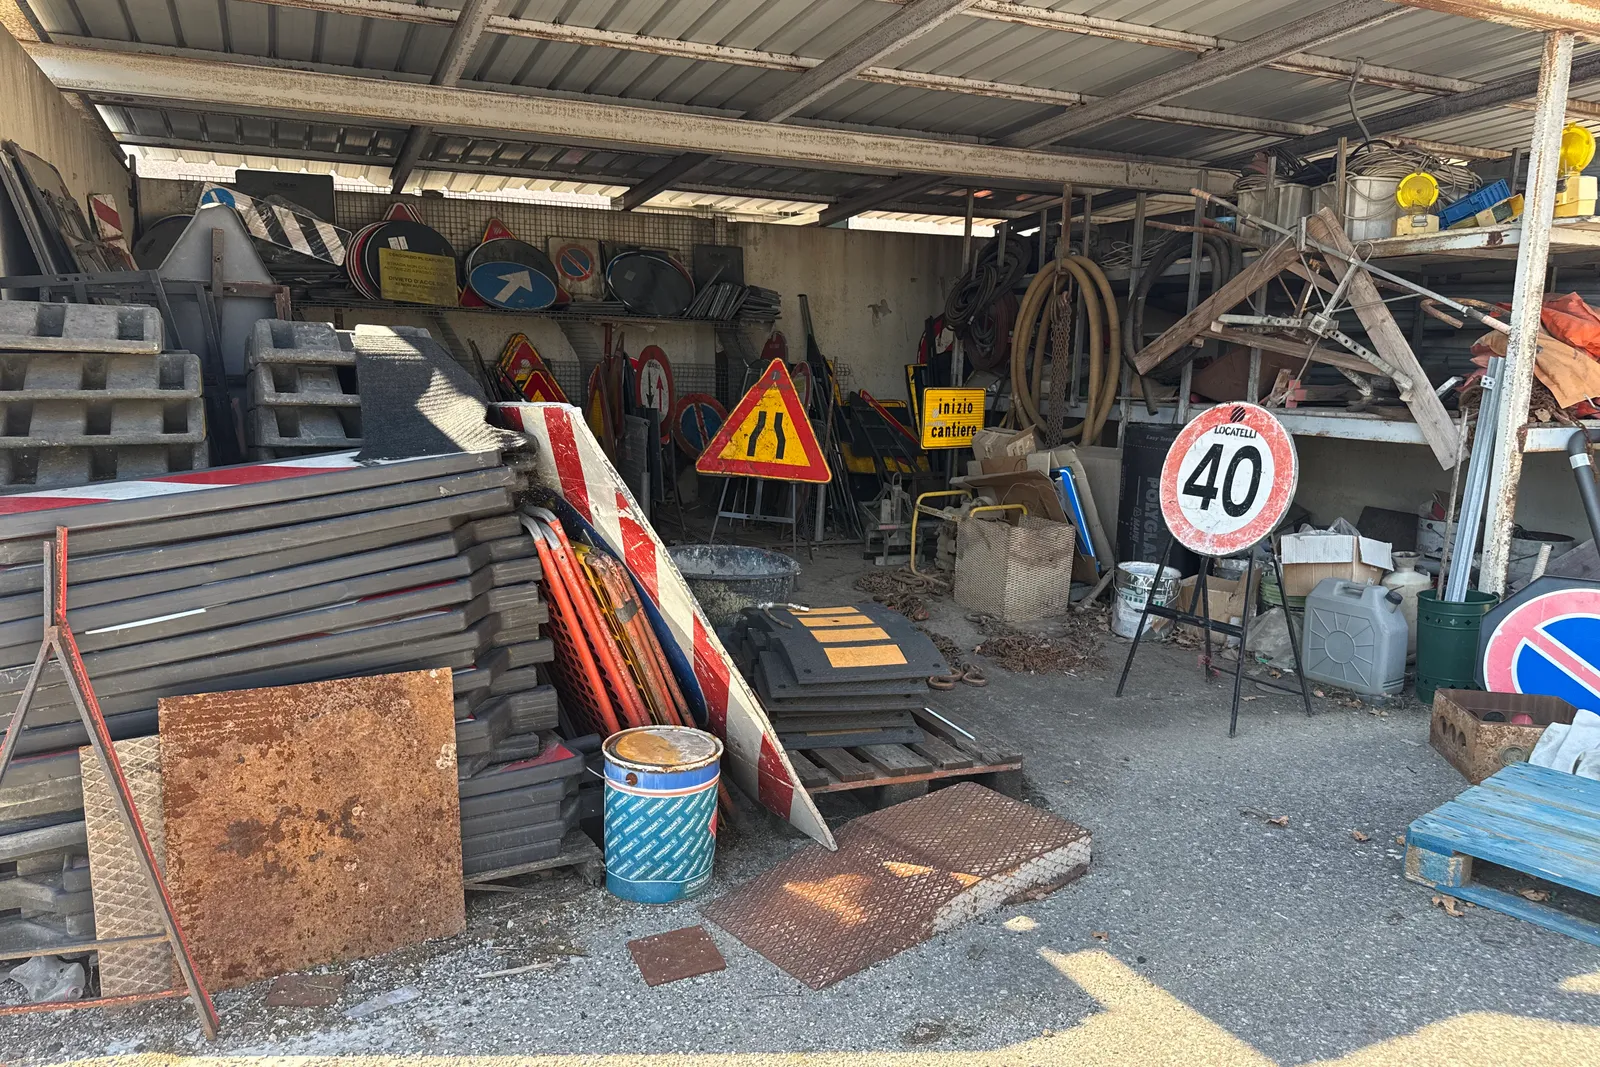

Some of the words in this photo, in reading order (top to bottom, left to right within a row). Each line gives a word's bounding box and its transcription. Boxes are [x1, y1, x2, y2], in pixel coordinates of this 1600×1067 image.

[939, 398, 972, 414] inizio
[932, 422, 976, 437] cantiere
[1214, 425, 1257, 438] LOCATELLI
[1182, 444, 1262, 517] 40
[1132, 518, 1141, 543] MAPEI
